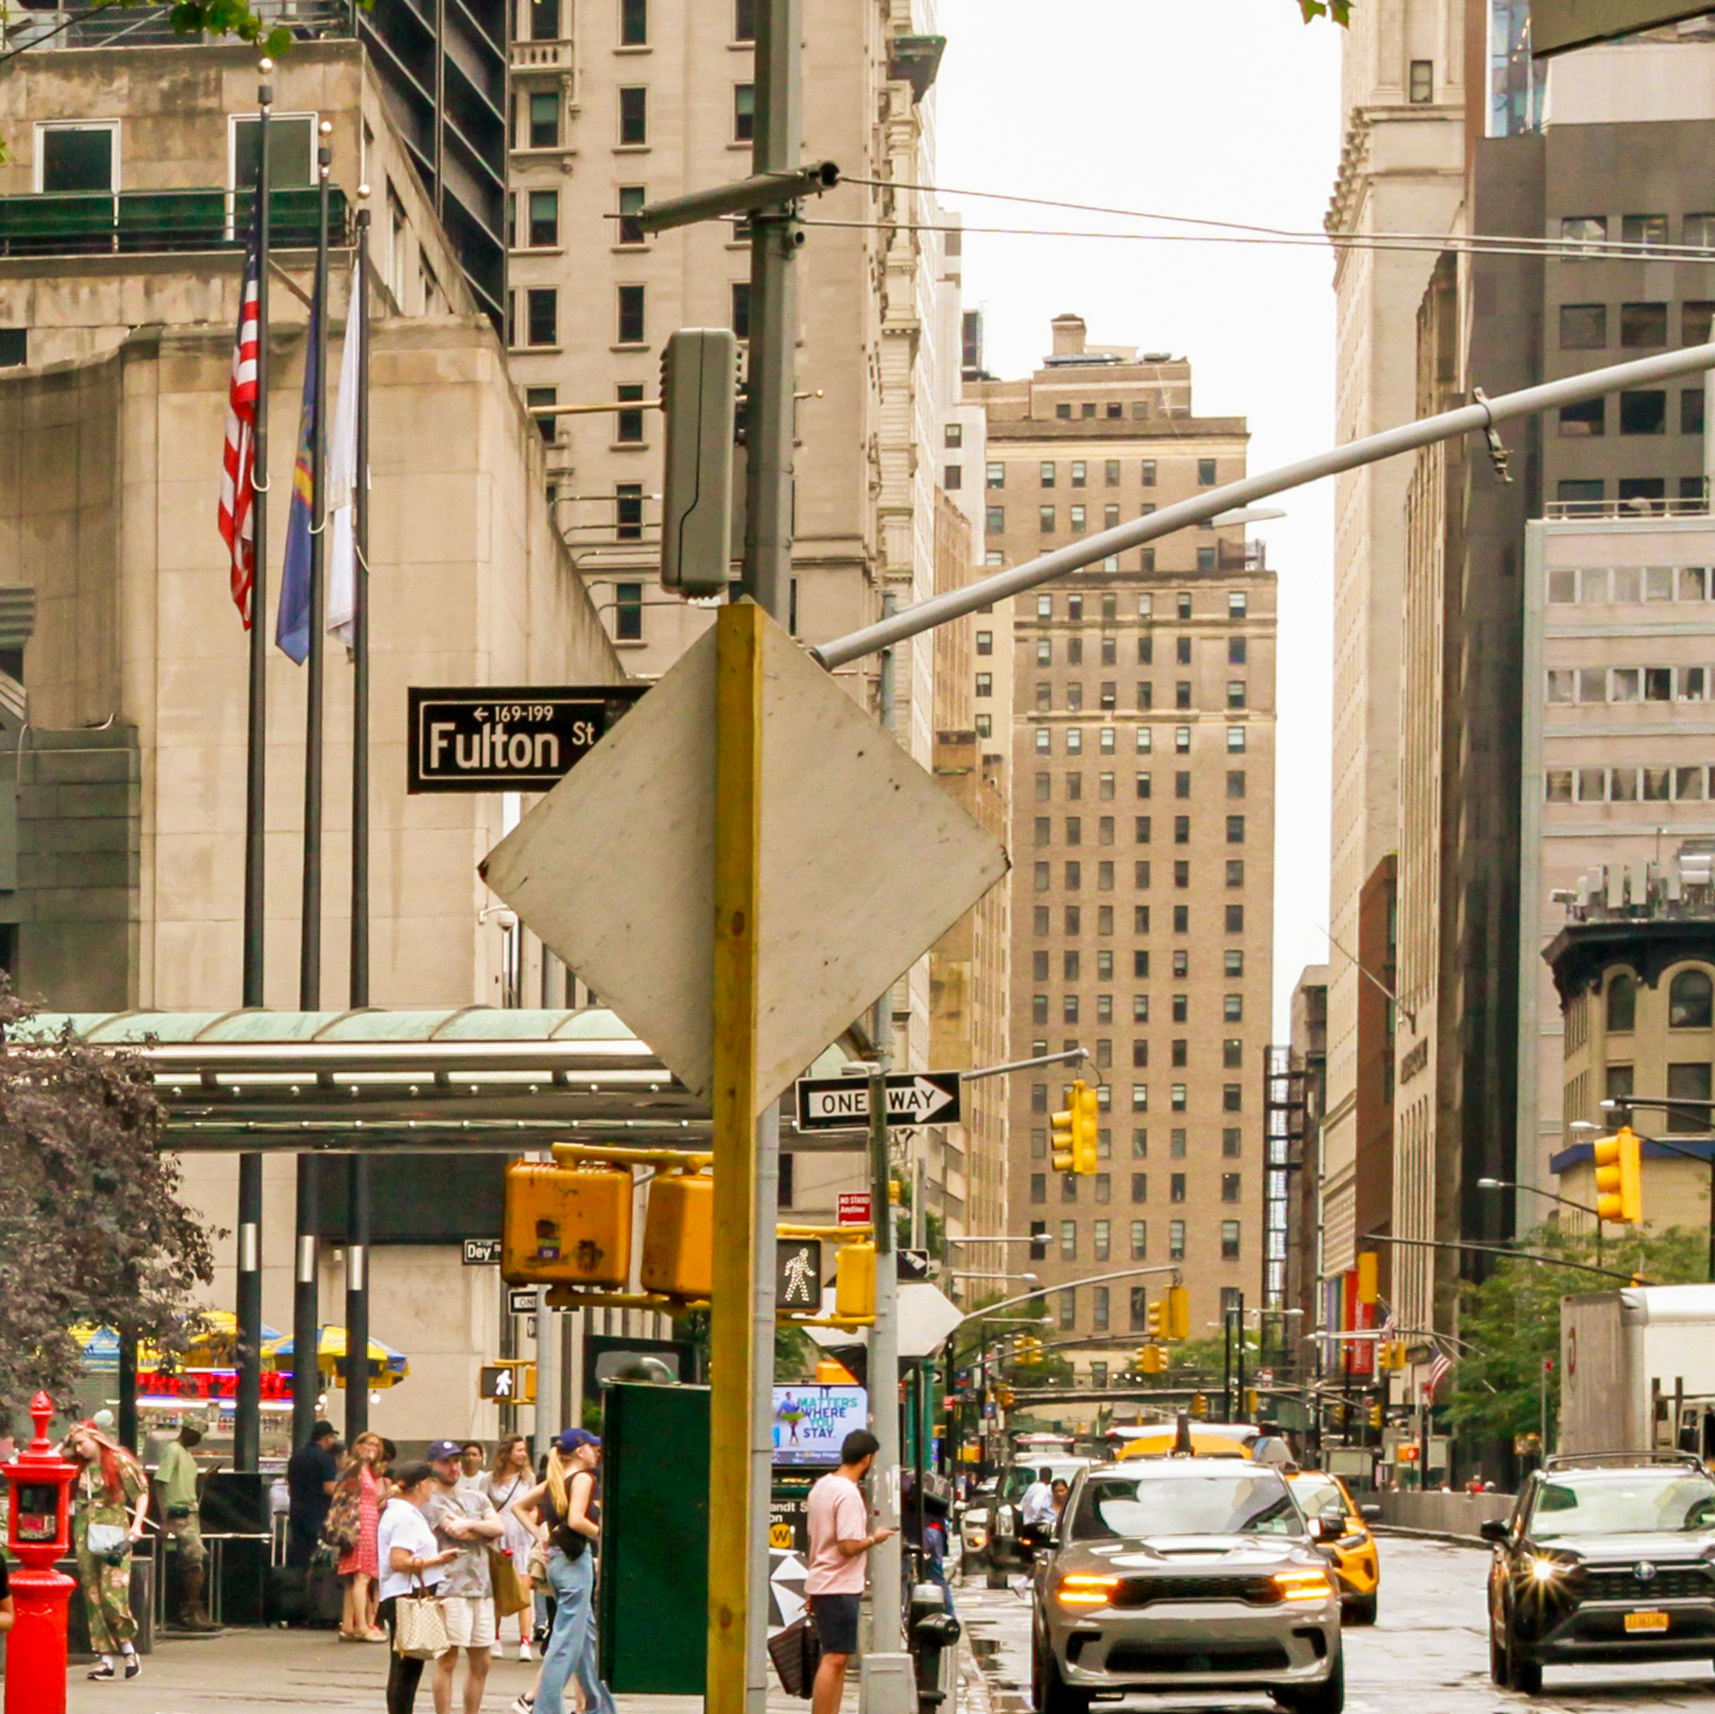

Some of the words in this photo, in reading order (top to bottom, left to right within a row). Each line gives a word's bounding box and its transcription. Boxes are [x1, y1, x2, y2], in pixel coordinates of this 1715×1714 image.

[494, 705, 554, 723] 169-199
[429, 721, 559, 769] Fulton
[572, 721, 595, 746] St
[821, 1093, 867, 1114] ONE
[888, 1089, 935, 1111] WAY
[467, 1243, 492, 1261] Dey
[797, 1397, 858, 1409] MATTERS
[802, 1406, 847, 1418] WHERE
[810, 1417, 835, 1428] YOU
[773, 1529, 790, 1543] W
